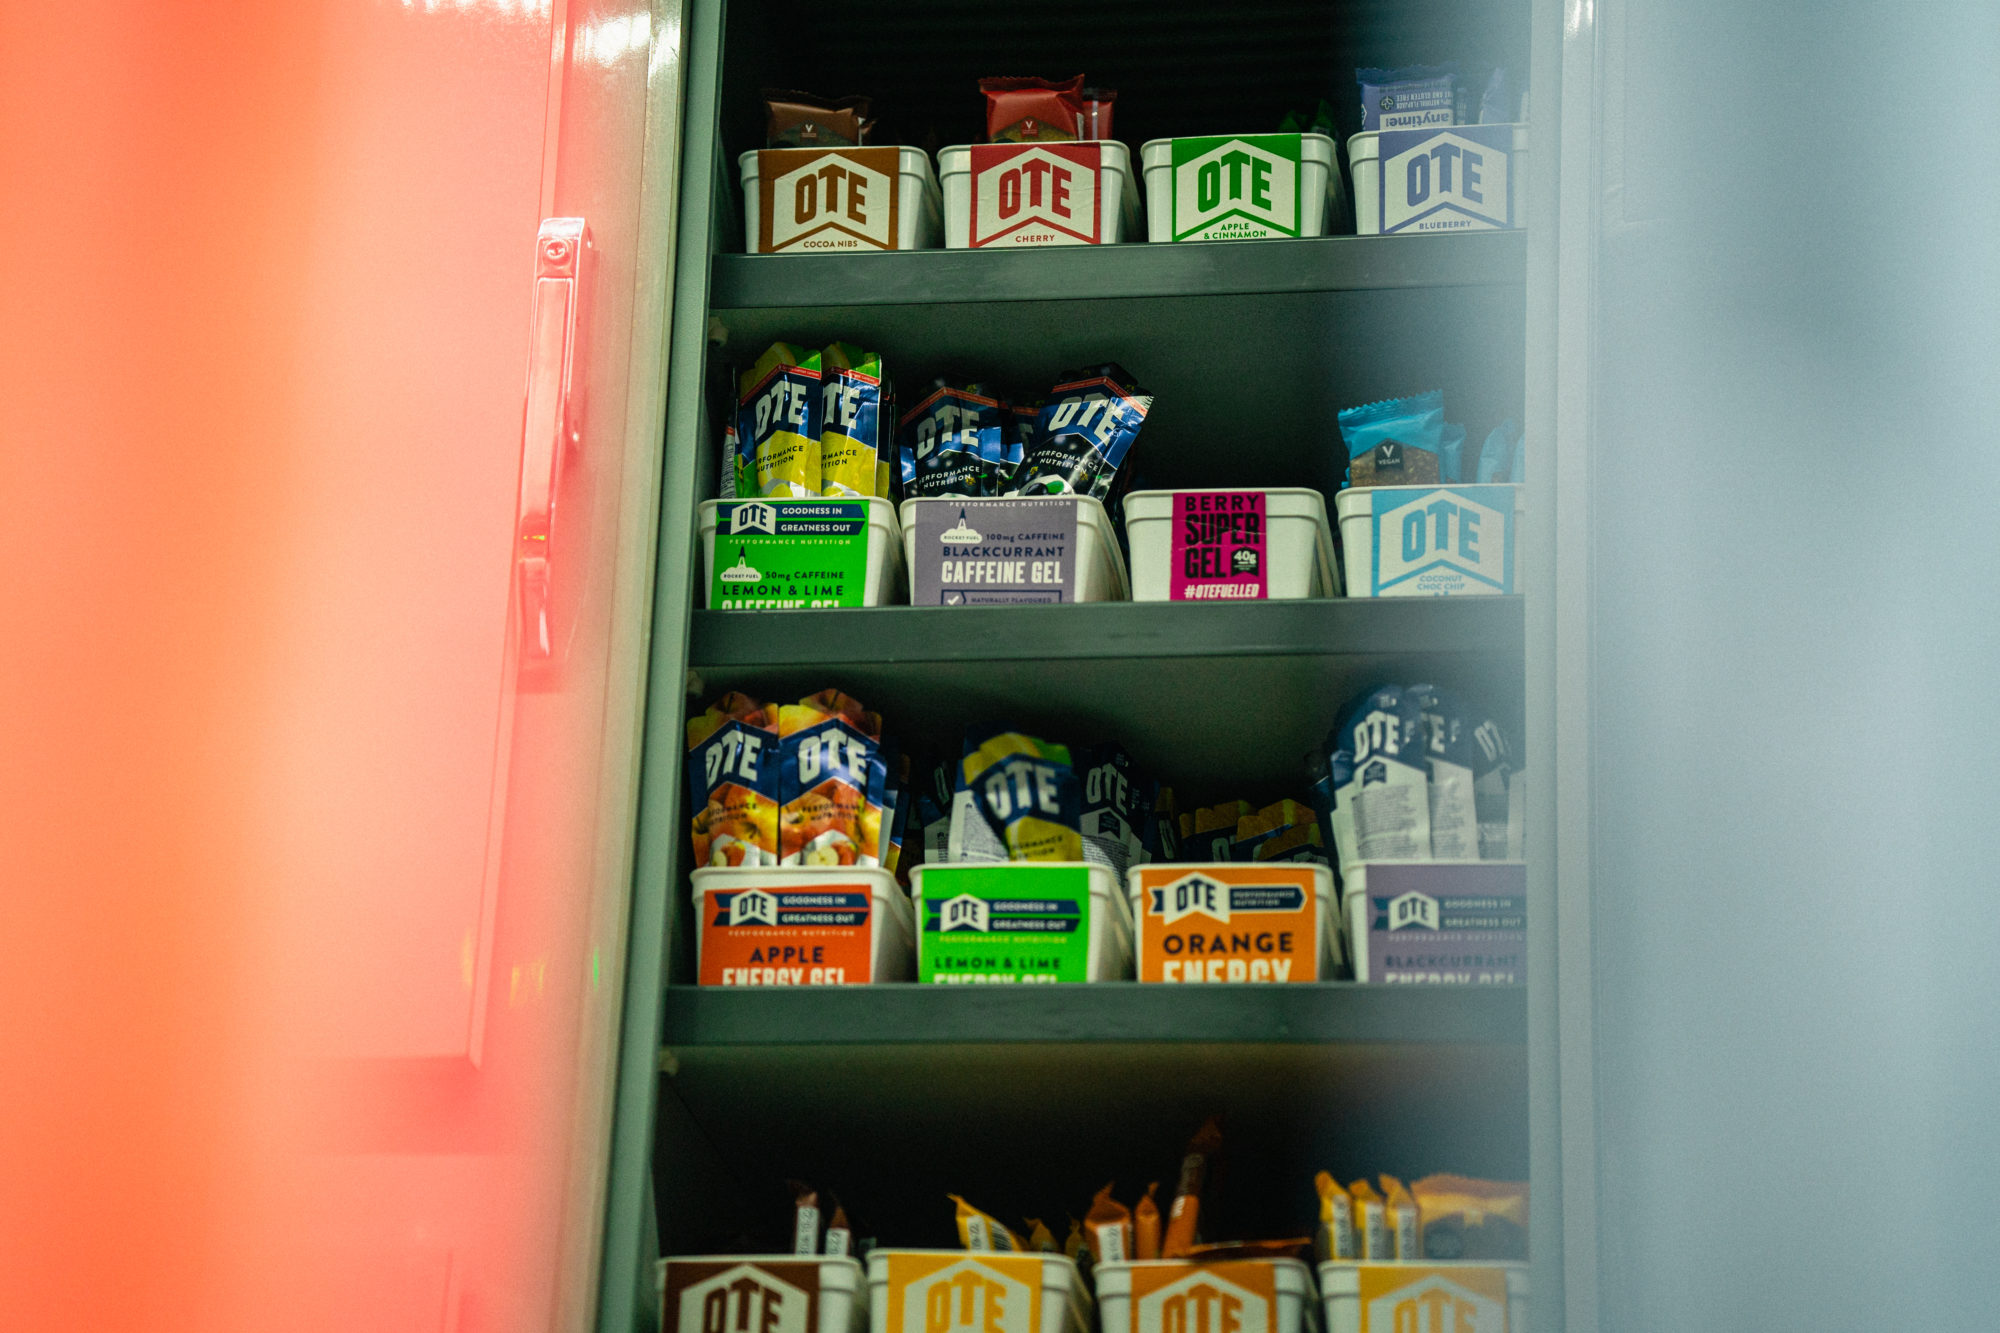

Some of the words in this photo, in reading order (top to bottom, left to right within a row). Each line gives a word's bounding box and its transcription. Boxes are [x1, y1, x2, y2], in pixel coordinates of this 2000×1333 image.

[1198, 149, 1272, 213] OTE
[1407, 142, 1483, 207] OTE
[795, 163, 868, 226] OTE
[999, 158, 1072, 220] OTE
[1220, 222, 1249, 231] APPLE
[1419, 219, 1472, 229] BLUEBERRY
[803, 240, 835, 248] COCOA
[837, 239, 858, 248] NIBS
[1015, 234, 1055, 243] CHERRY
[1203, 231, 1211, 239] &
[1212, 230, 1267, 239] CINNAMON
[755, 380, 806, 439] OTE
[822, 383, 860, 430] TE
[1048, 392, 1123, 446] OTE
[917, 405, 980, 460] OTE
[758, 445, 804, 464] RFORMANCE
[1378, 458, 1400, 466] VEGAN
[923, 473, 971, 489] NUTRITION
[781, 506, 831, 516] GOODNESS
[832, 506, 842, 515] IN
[950, 500, 1017, 508] PERFORMANCE
[1185, 495, 1259, 511] BERRY
[739, 504, 768, 527] OTE
[780, 523, 831, 532] GREATNESS
[832, 523, 851, 532] OUT
[1185, 513, 1260, 545] SUPER
[1401, 499, 1481, 564] OTE
[986, 533, 1014, 543] 100mg
[1018, 533, 1065, 541] CAFFEINE
[942, 546, 1064, 557] BLACKCURRANT
[941, 561, 1025, 583] CAFFEINE
[1031, 561, 1063, 583] GEL
[1185, 547, 1226, 579] GEL
[765, 571, 791, 581] 50mg
[794, 571, 844, 580] CAFFEINE
[1419, 574, 1462, 583] COCONUT
[722, 585, 783, 596] LEMON
[788, 585, 797, 596] &
[804, 585, 844, 596] LIME
[1184, 584, 1259, 599] #OTEFUELLED
[1417, 583, 1441, 592] CHOC
[1442, 582, 1465, 591] CHIP
[1353, 710, 1400, 764] OTE
[705, 729, 762, 790] OTE
[798, 728, 867, 786] OTE
[985, 760, 1061, 820] OTE
[1086, 763, 1128, 815] OTE
[739, 893, 768, 917] OTE
[782, 896, 833, 905] GOODNESS
[835, 896, 847, 905] IN
[1177, 878, 1216, 912] OTE
[950, 898, 979, 922] OTE
[993, 903, 1044, 912] GOODNESS
[1399, 893, 1429, 921] OTE
[781, 914, 834, 924] GREATNESS
[835, 913, 855, 923] OUT
[992, 921, 1046, 930] GREATNESS
[1048, 920, 1067, 929] OUT
[1163, 932, 1294, 955] ORANGE
[749, 946, 824, 964] APPLE
[934, 957, 996, 969] LEMON
[1019, 957, 1061, 969] LIME
[1385, 955, 1518, 968] BLACKCURRANT
[704, 1276, 783, 1333] OTE
[926, 1269, 1008, 1333] OTE
[1162, 1283, 1243, 1333] OTE
